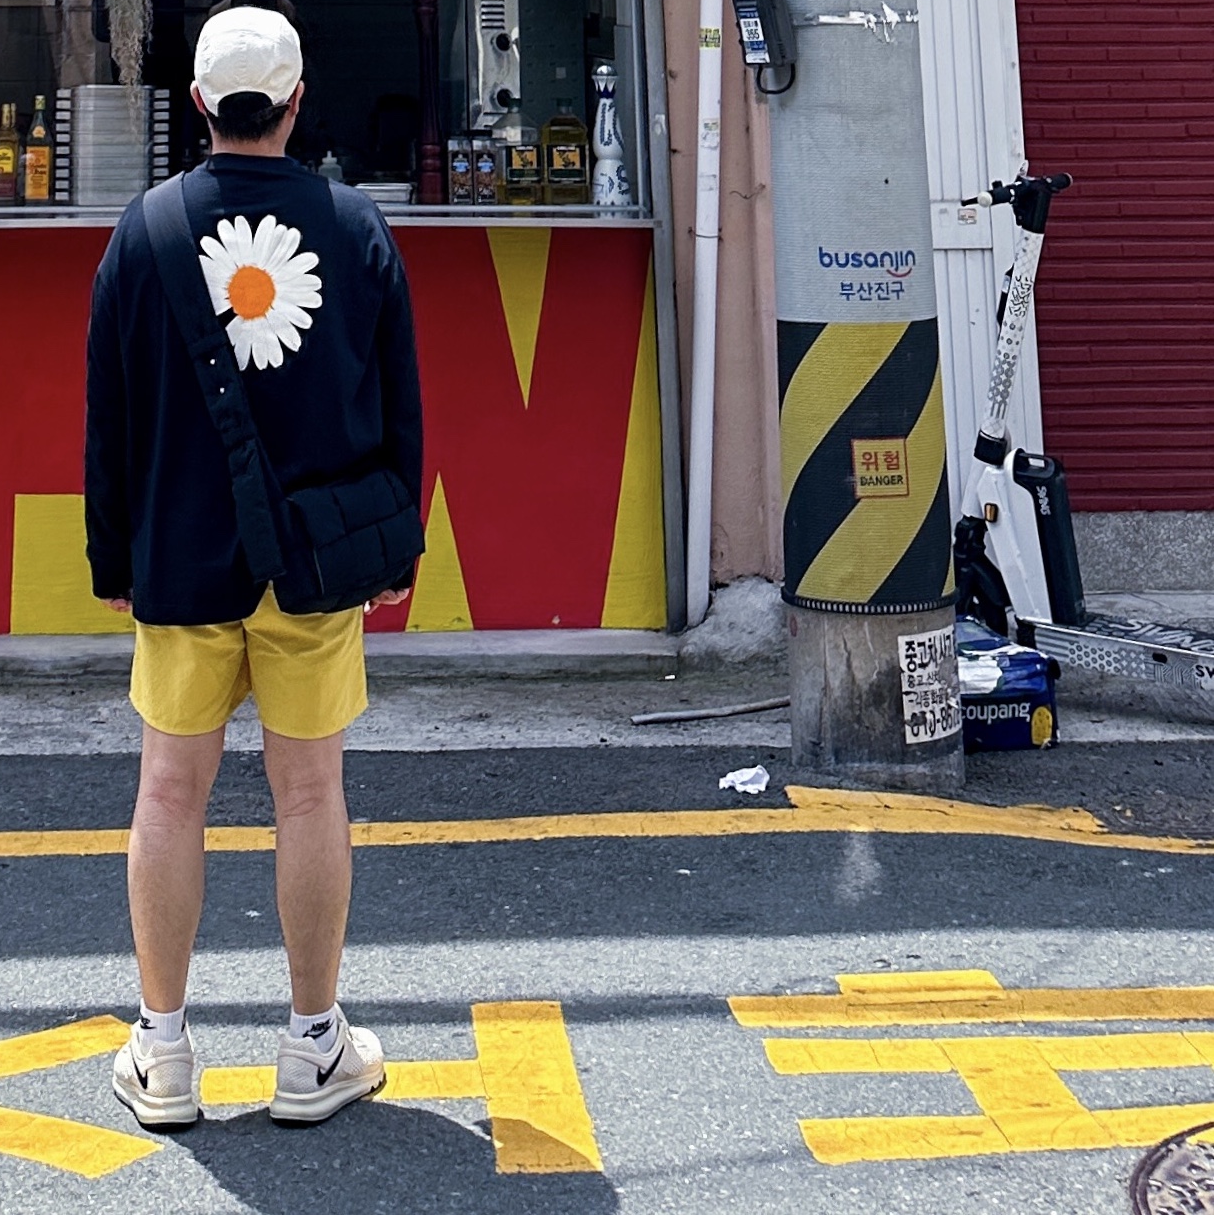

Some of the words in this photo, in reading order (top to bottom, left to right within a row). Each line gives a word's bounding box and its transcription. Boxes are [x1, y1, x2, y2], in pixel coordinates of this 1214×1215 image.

[819, 247, 916, 273] busanjin
[840, 281, 905, 301] 부산진구
[860, 450, 901, 471] 위험
[859, 474, 904, 488] DANGER
[961, 702, 1030, 725] coupang
